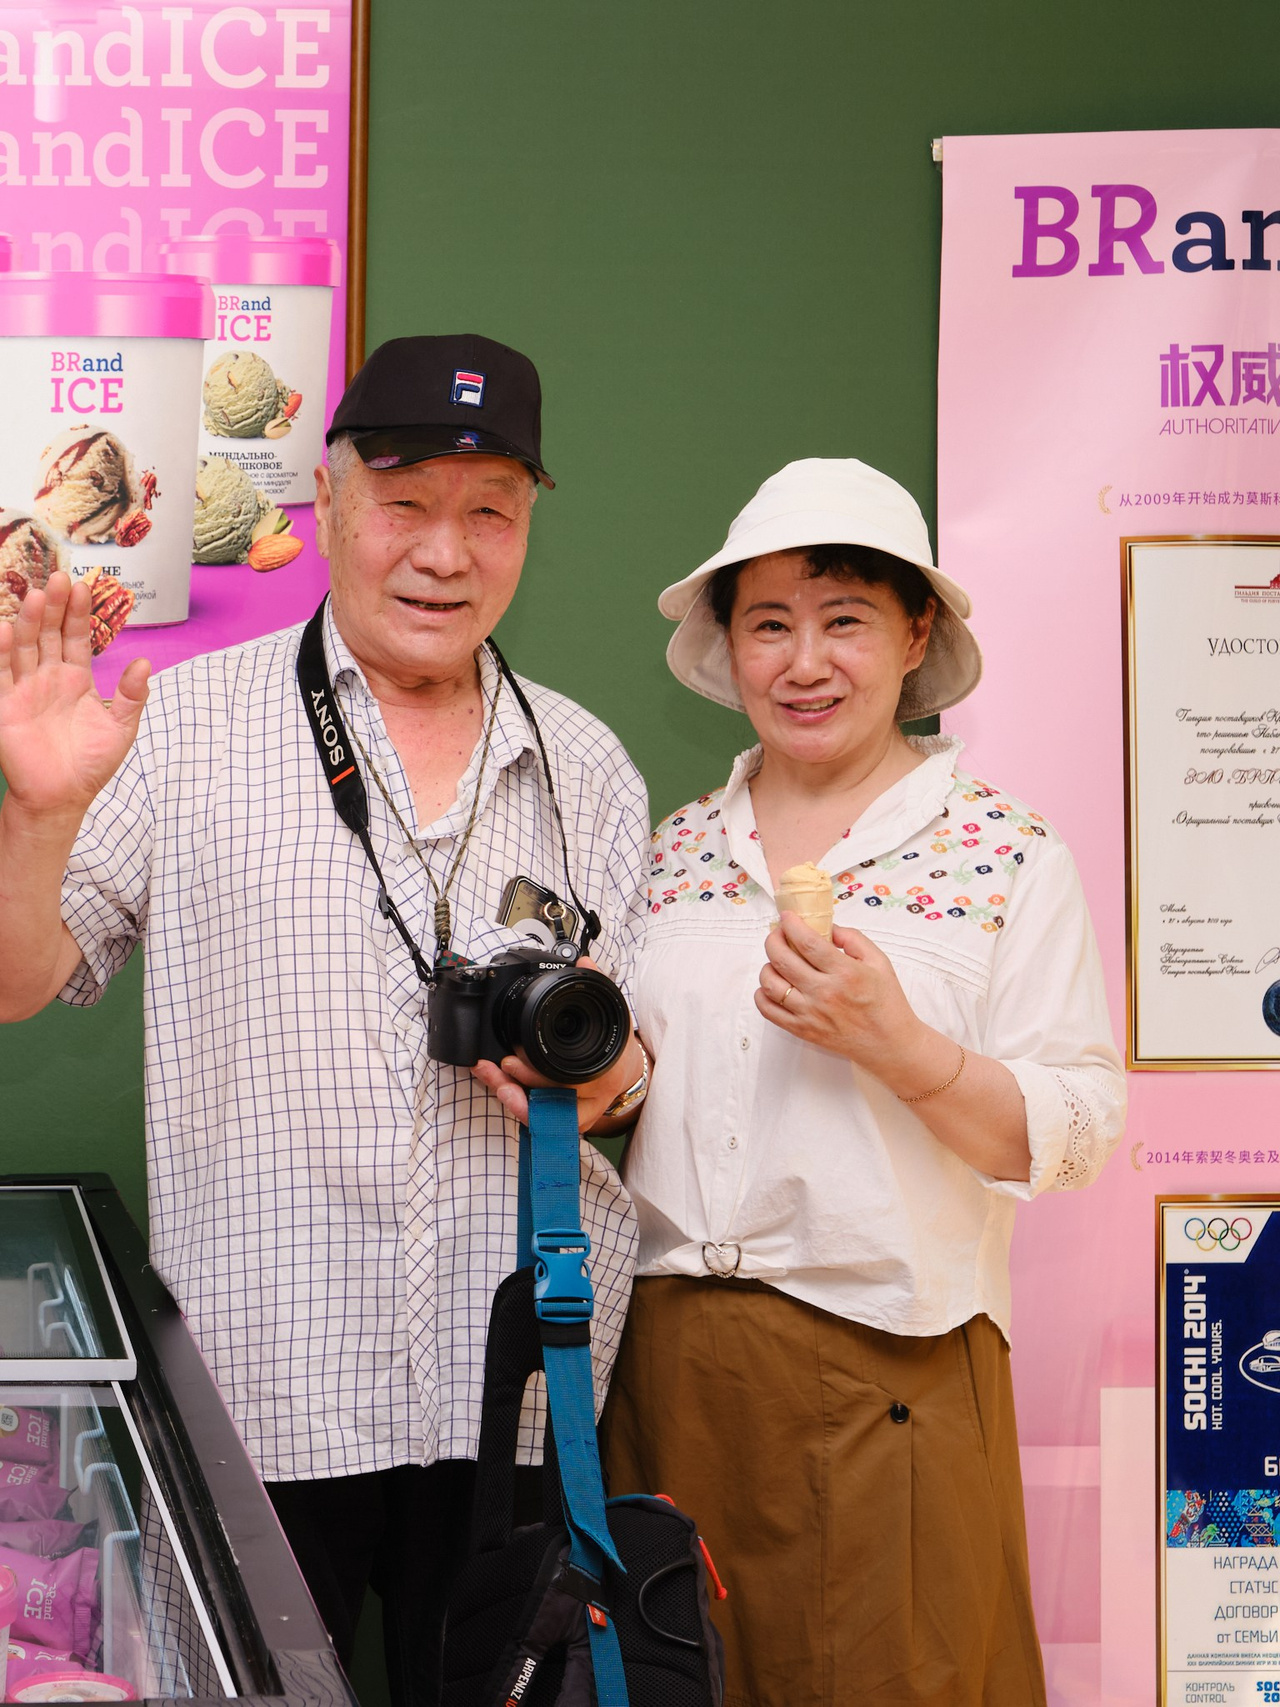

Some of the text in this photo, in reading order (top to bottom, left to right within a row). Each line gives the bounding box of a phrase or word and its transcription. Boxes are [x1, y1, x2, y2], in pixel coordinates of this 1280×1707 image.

[218, 296, 271, 311] BRand
[218, 315, 271, 342] ICE
[51, 352, 124, 372] BRand
[1159, 343, 1280, 408] 权威
[50, 377, 124, 414] ICE
[1207, 638, 1280, 657] УДОСТО
[311, 689, 345, 766] SONY
[538, 962, 567, 970] SONY
[1184, 1275, 1207, 1431] SOCHI 2014
[1212, 1319, 1223, 1431] HOT. COOL. YOURS.
[26, 1414, 42, 1446] ICE
[1214, 1556, 1278, 1571] НАГРАДА
[1230, 1581, 1278, 1594] СТАТУС
[23, 1578, 48, 1619] ICE
[1214, 1605, 1278, 1621] ДОГОВОР
[1217, 1630, 1278, 1643] от СЕМЬИ
[510, 1657, 537, 1700] ARPENAZ
[1185, 1682, 1235, 1692] КОНТРОЛЬ
[1185, 1694, 1227, 1703] CONTROL
